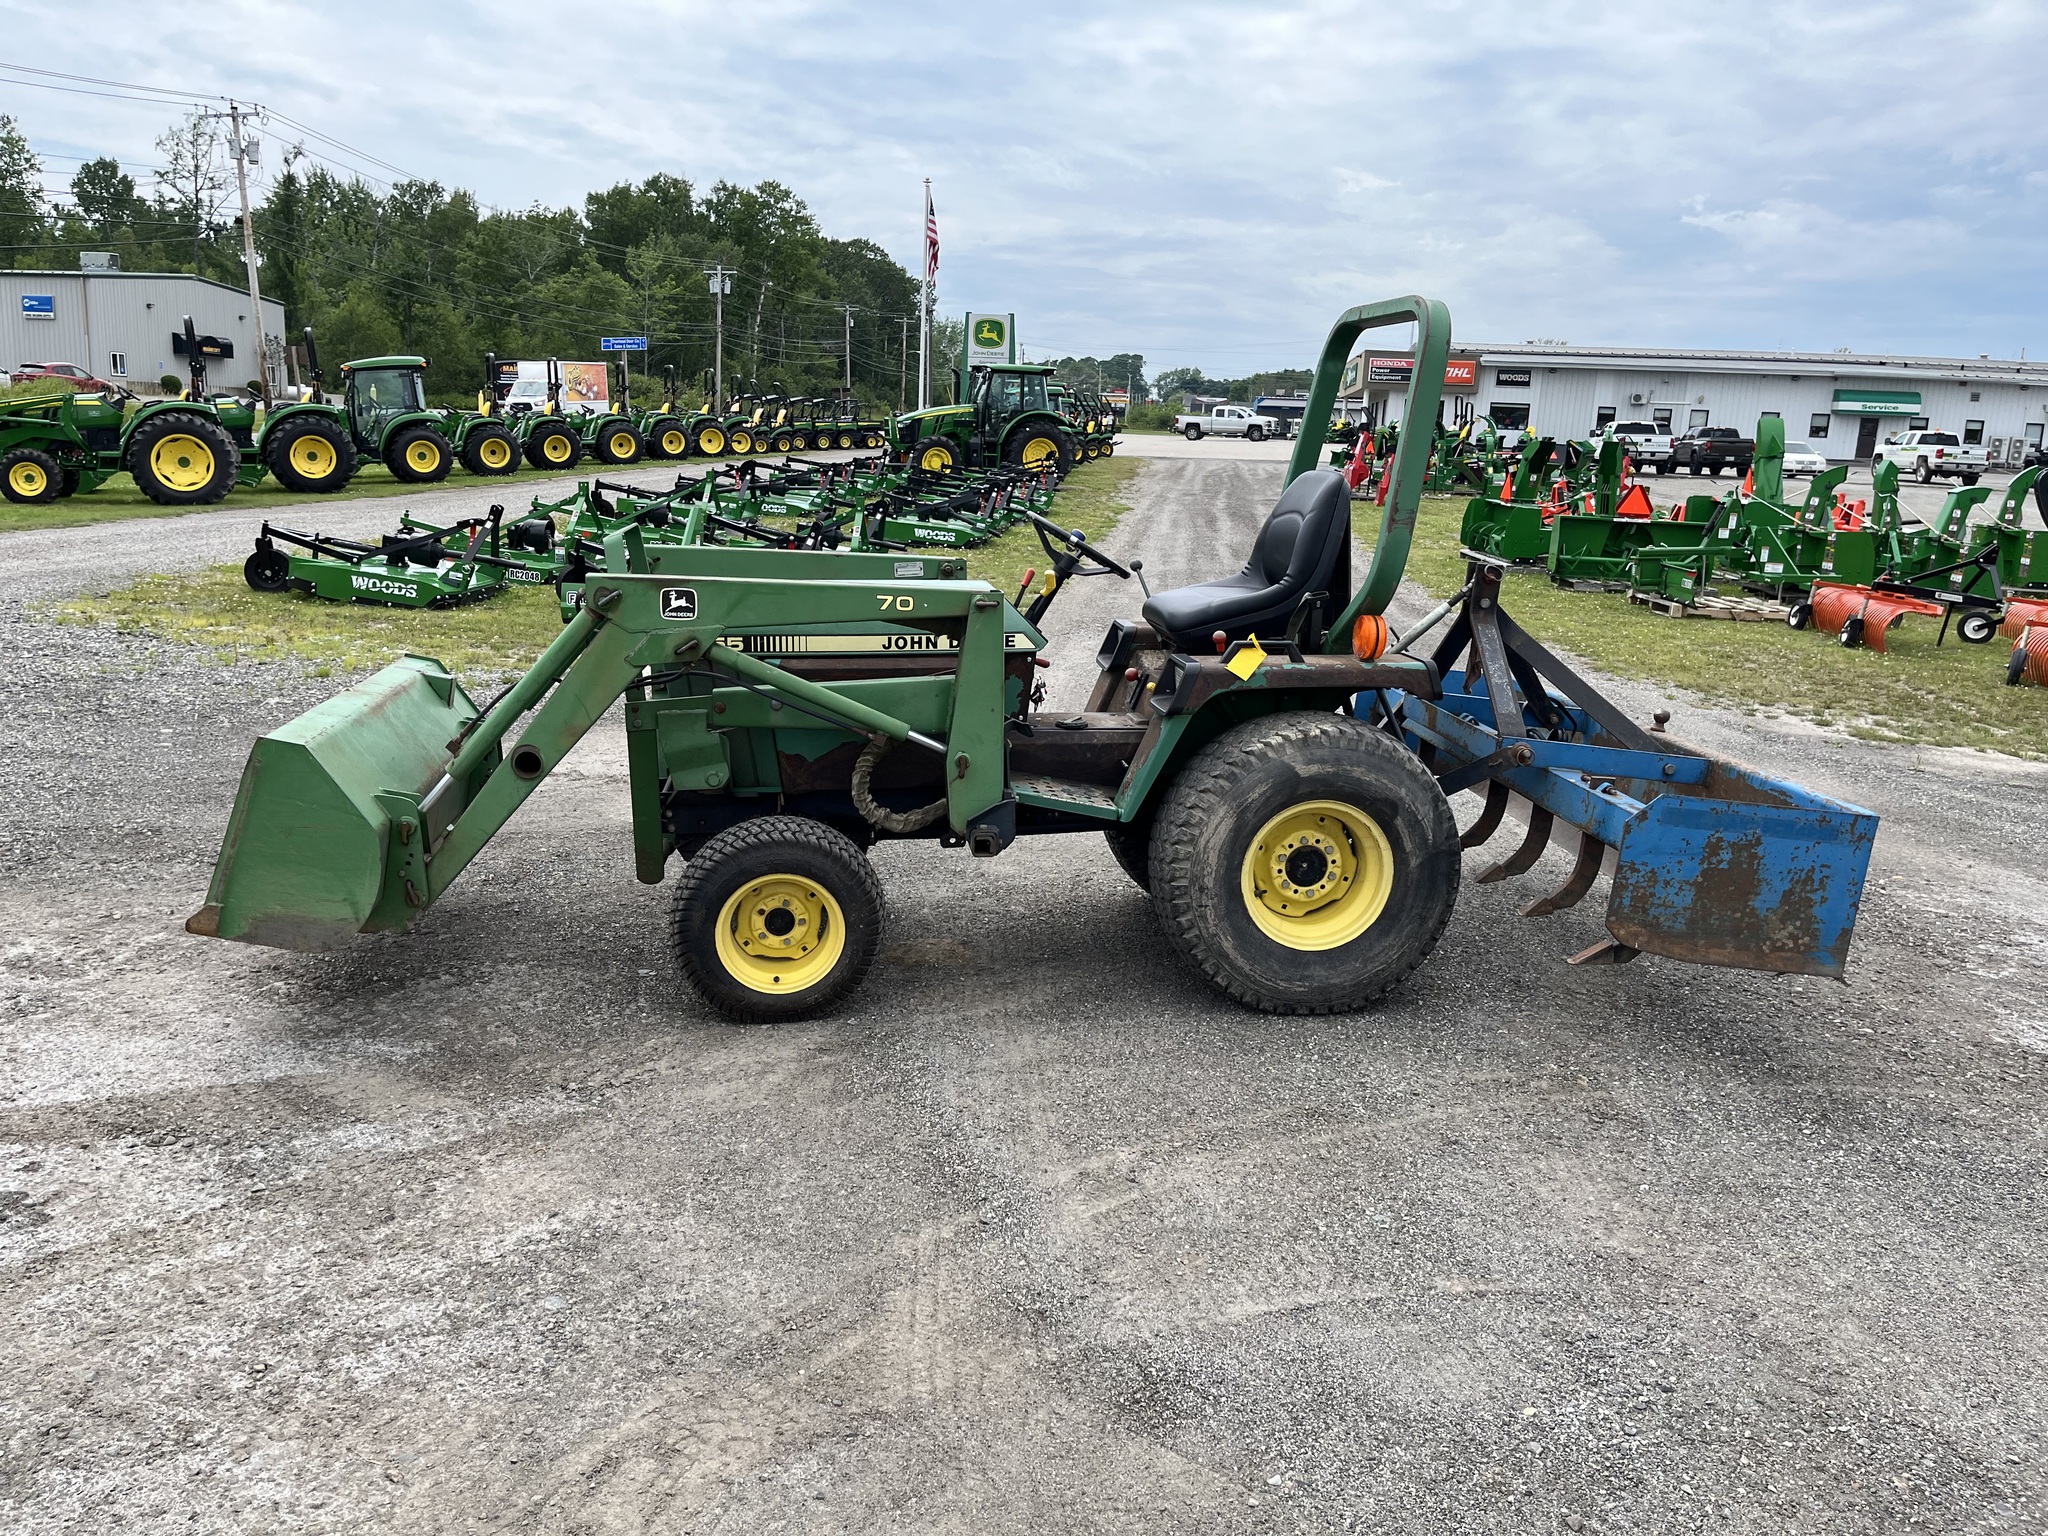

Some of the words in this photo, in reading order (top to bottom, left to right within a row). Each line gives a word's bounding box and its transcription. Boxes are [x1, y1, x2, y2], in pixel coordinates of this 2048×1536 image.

[1445, 367, 1471, 378] TIHL
[1499, 373, 1530, 382] WOODS
[1861, 403, 1899, 411] Service
[761, 503, 787, 513] OODS
[914, 528, 956, 542] WOODS
[509, 569, 540, 582] RC2048
[351, 575, 418, 598] WOODS
[876, 594, 914, 611] 70
[882, 635, 938, 650] JOHN
